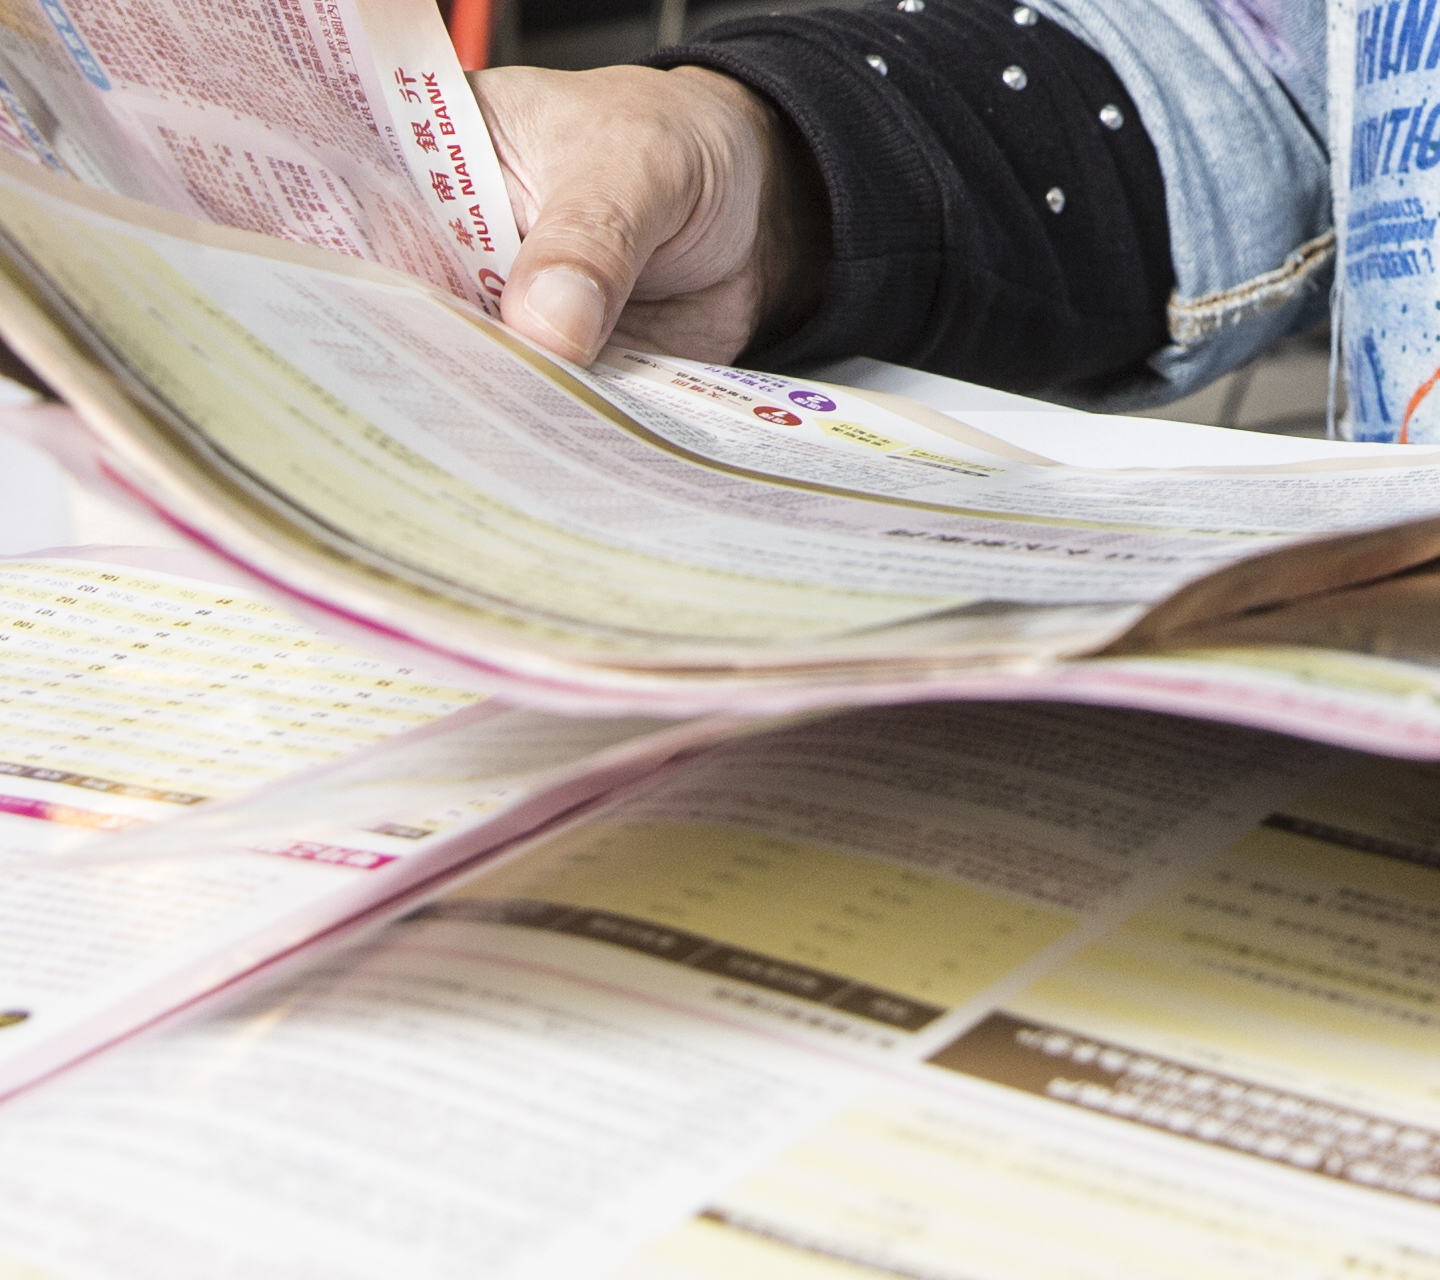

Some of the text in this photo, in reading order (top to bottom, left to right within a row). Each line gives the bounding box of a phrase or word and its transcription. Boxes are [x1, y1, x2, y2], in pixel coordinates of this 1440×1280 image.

[394, 68, 477, 248] 華南銀行
[422, 72, 496, 249] HUA NAN BANK
[671, 377, 741, 406] 一次領回
[703, 365, 774, 393] 分期給付
